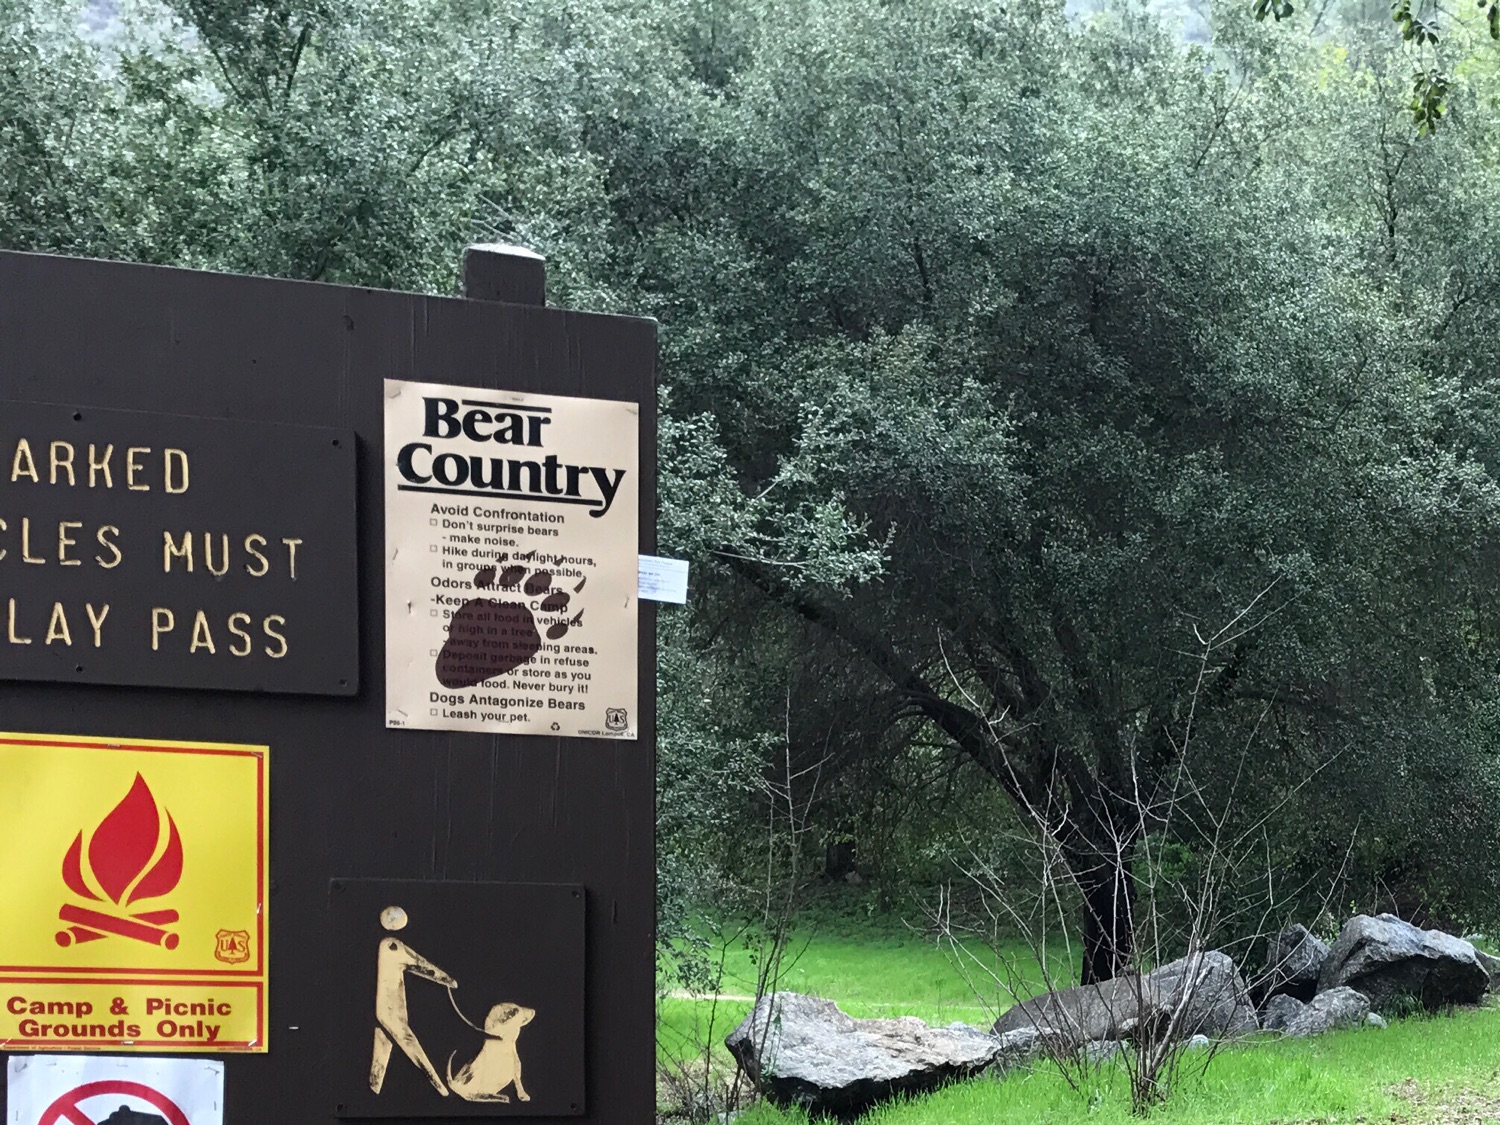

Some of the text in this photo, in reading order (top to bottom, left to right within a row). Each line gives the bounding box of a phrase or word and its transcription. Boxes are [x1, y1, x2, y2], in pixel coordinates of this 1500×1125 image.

[422, 397, 552, 447] Bear
[11, 438, 189, 494] ARKED
[397, 442, 626, 518] Country
[430, 503, 565, 524] Avoid Confrontation
[442, 519, 559, 537] Don't surprise bears
[0, 517, 302, 580] LES MUST
[450, 534, 480, 545] make
[484, 536, 519, 548] noise.
[442, 546, 597, 567] Hike during daylight hours,
[442, 560, 452, 569] in
[457, 562, 497, 574] groups
[501, 565, 531, 575] when
[430, 577, 563, 596] Odors Attract Bears
[474, 597, 483, 608] A
[488, 598, 526, 610] Clean
[529, 600, 568, 614] Camp
[9, 598, 288, 658] LAY PASS
[442, 609, 474, 621] Store
[537, 615, 583, 628] vehicles
[513, 641, 560, 655] sleeping
[563, 645, 598, 655] areas.
[540, 655, 550, 665] in
[554, 656, 589, 668] refuse
[506, 668, 519, 677] or
[522, 668, 551, 679] store
[554, 670, 568, 679] as
[571, 672, 591, 683] you
[512, 680, 546, 692] Never
[549, 682, 574, 695] bury
[577, 682, 588, 694] it!
[429, 691, 586, 711] Dogs Antagonize Bears
[442, 708, 531, 724] Leash your pet.
[6, 996, 232, 1018] Camp & Picnic
[18, 1019, 221, 1042] Grounds Only
